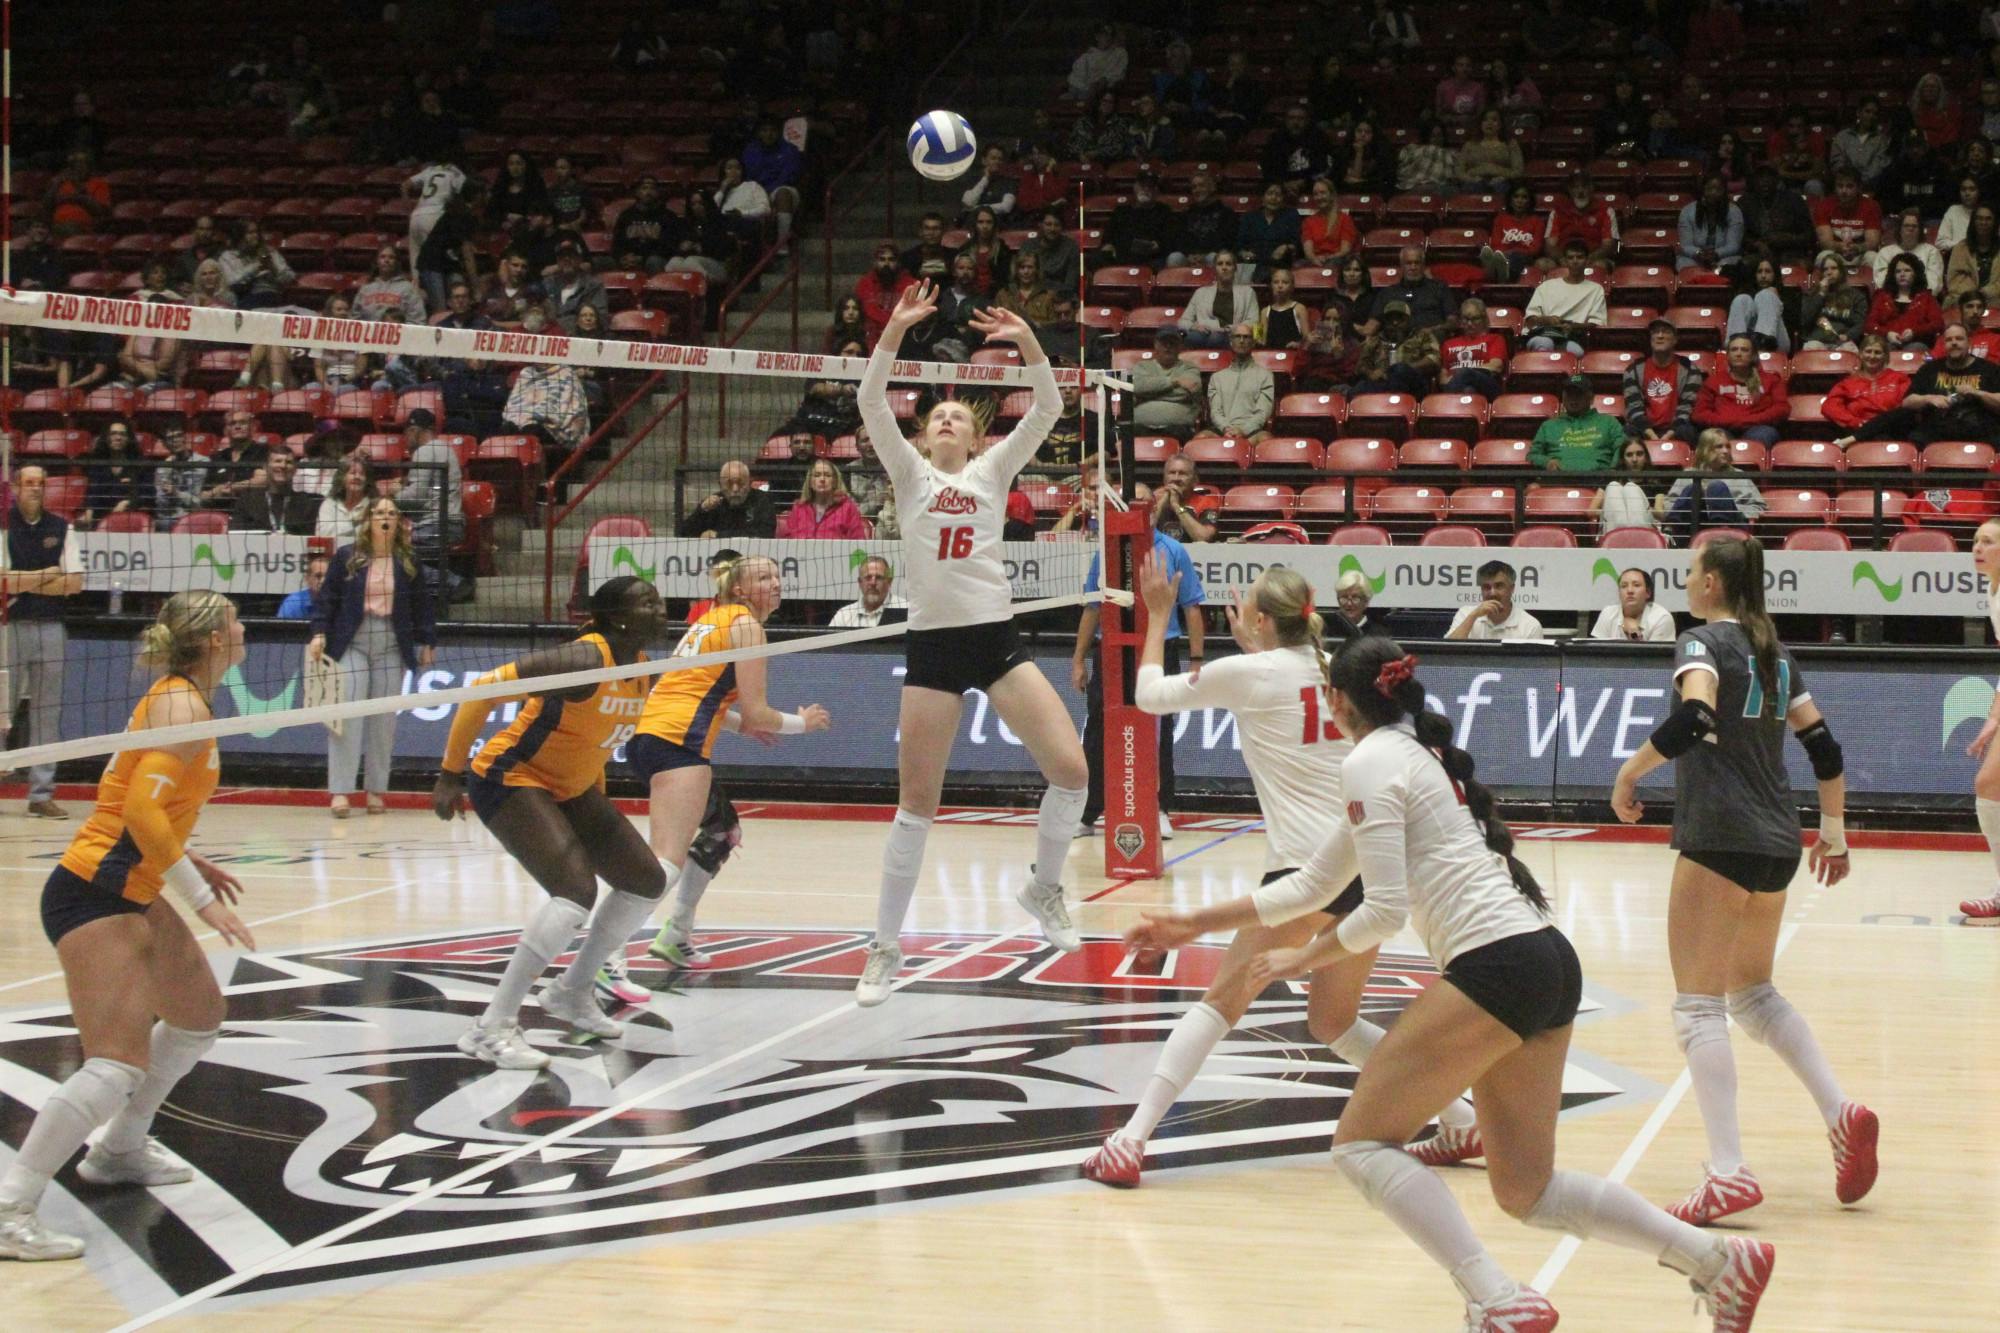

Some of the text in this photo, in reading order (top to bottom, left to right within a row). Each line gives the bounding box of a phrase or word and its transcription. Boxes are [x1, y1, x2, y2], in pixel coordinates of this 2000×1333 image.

[423, 173, 446, 199] 5
[43, 294, 192, 331] NEW MEXICO LOBOS
[283, 316, 402, 345] NEW MEXICO LOBOS
[473, 331, 571, 357] NEW MEXICO LOBOS
[628, 343, 708, 366] NEW MEXICO LOBOS
[928, 487, 977, 514] Lobos
[938, 526, 974, 560] 16
[80, 551, 148, 570] ENDA
[244, 553, 309, 574] NUSE
[1193, 562, 1285, 584] SEND
[1395, 564, 1539, 587] NUSEA
[1912, 571, 1989, 593] NUSE
[1012, 586, 1040, 596] NION
[1207, 590, 1246, 600] CREDT
[1513, 593, 1539, 603] NION
[1767, 598, 1797, 608] NION
[1300, 685, 1346, 745] 1
[1526, 687, 1665, 758] WE
[1122, 726, 1135, 817] sports imports
